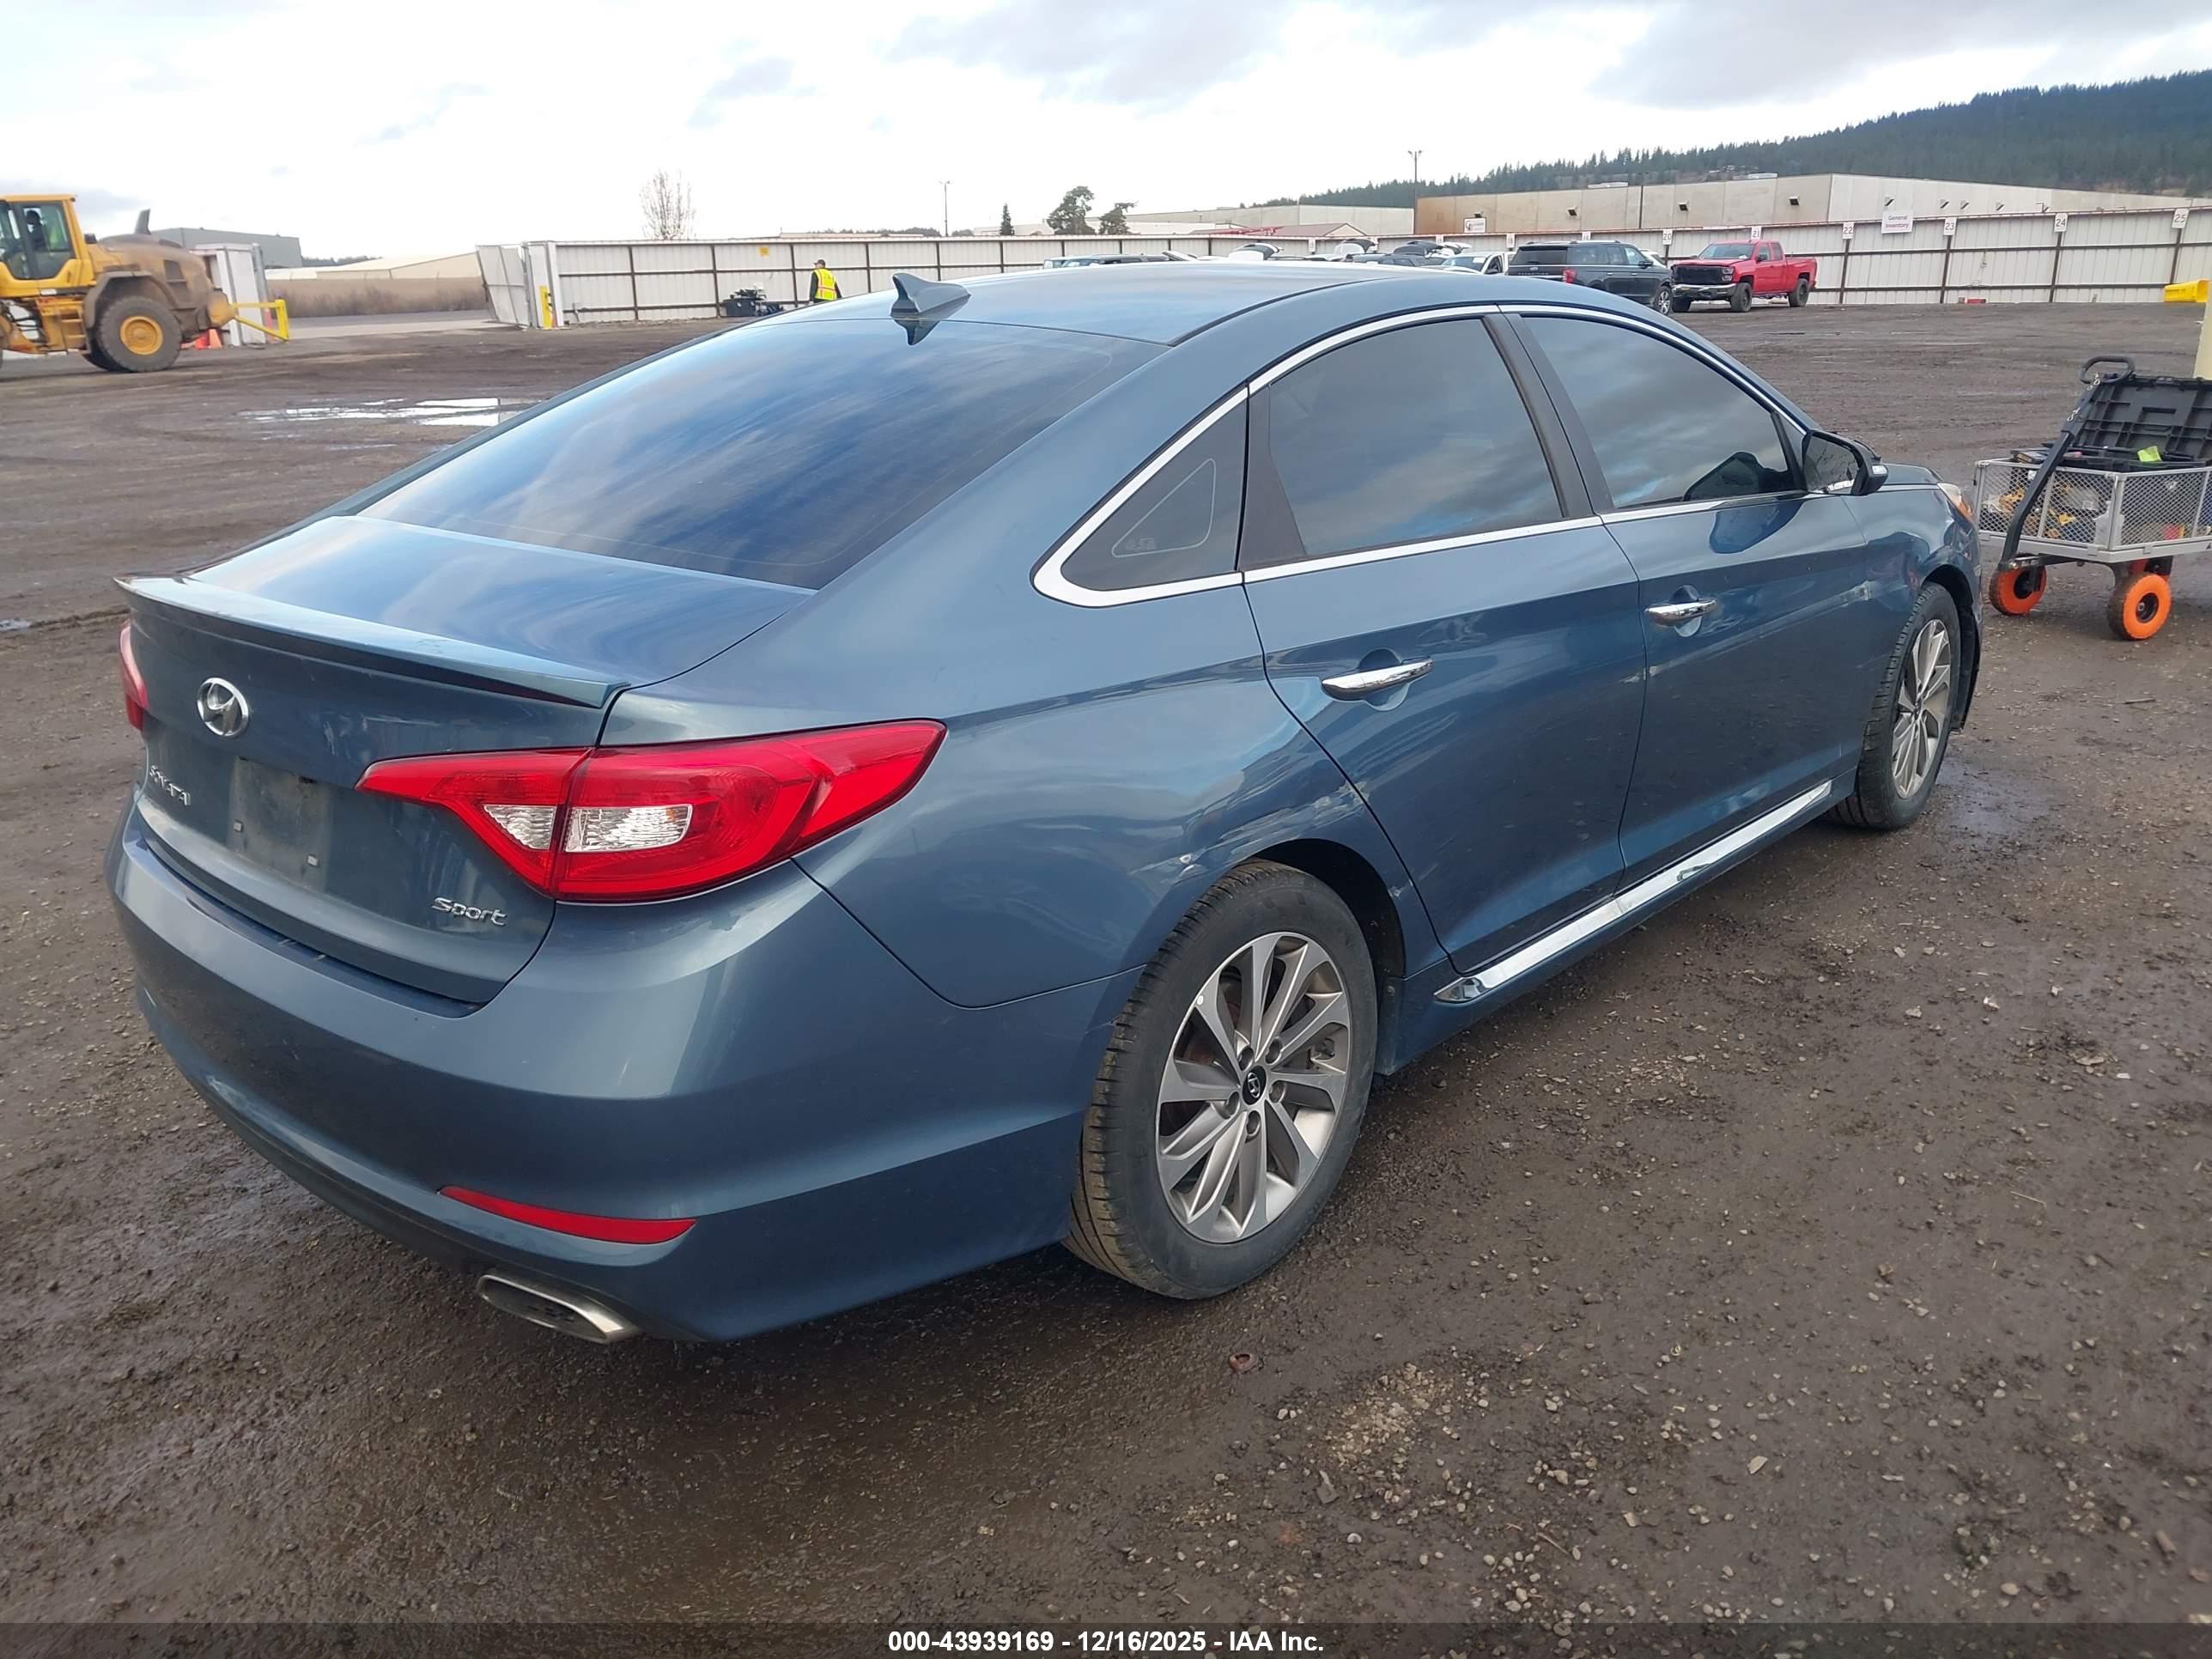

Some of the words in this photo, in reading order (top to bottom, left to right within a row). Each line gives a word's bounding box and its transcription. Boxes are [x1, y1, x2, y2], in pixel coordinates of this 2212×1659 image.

[2055, 218, 2066, 228] 24
[2174, 215, 2185, 223] 25
[1945, 222, 1954, 230] 23
[1662, 233, 1672, 241] 20
[431, 896, 507, 927] Sport
